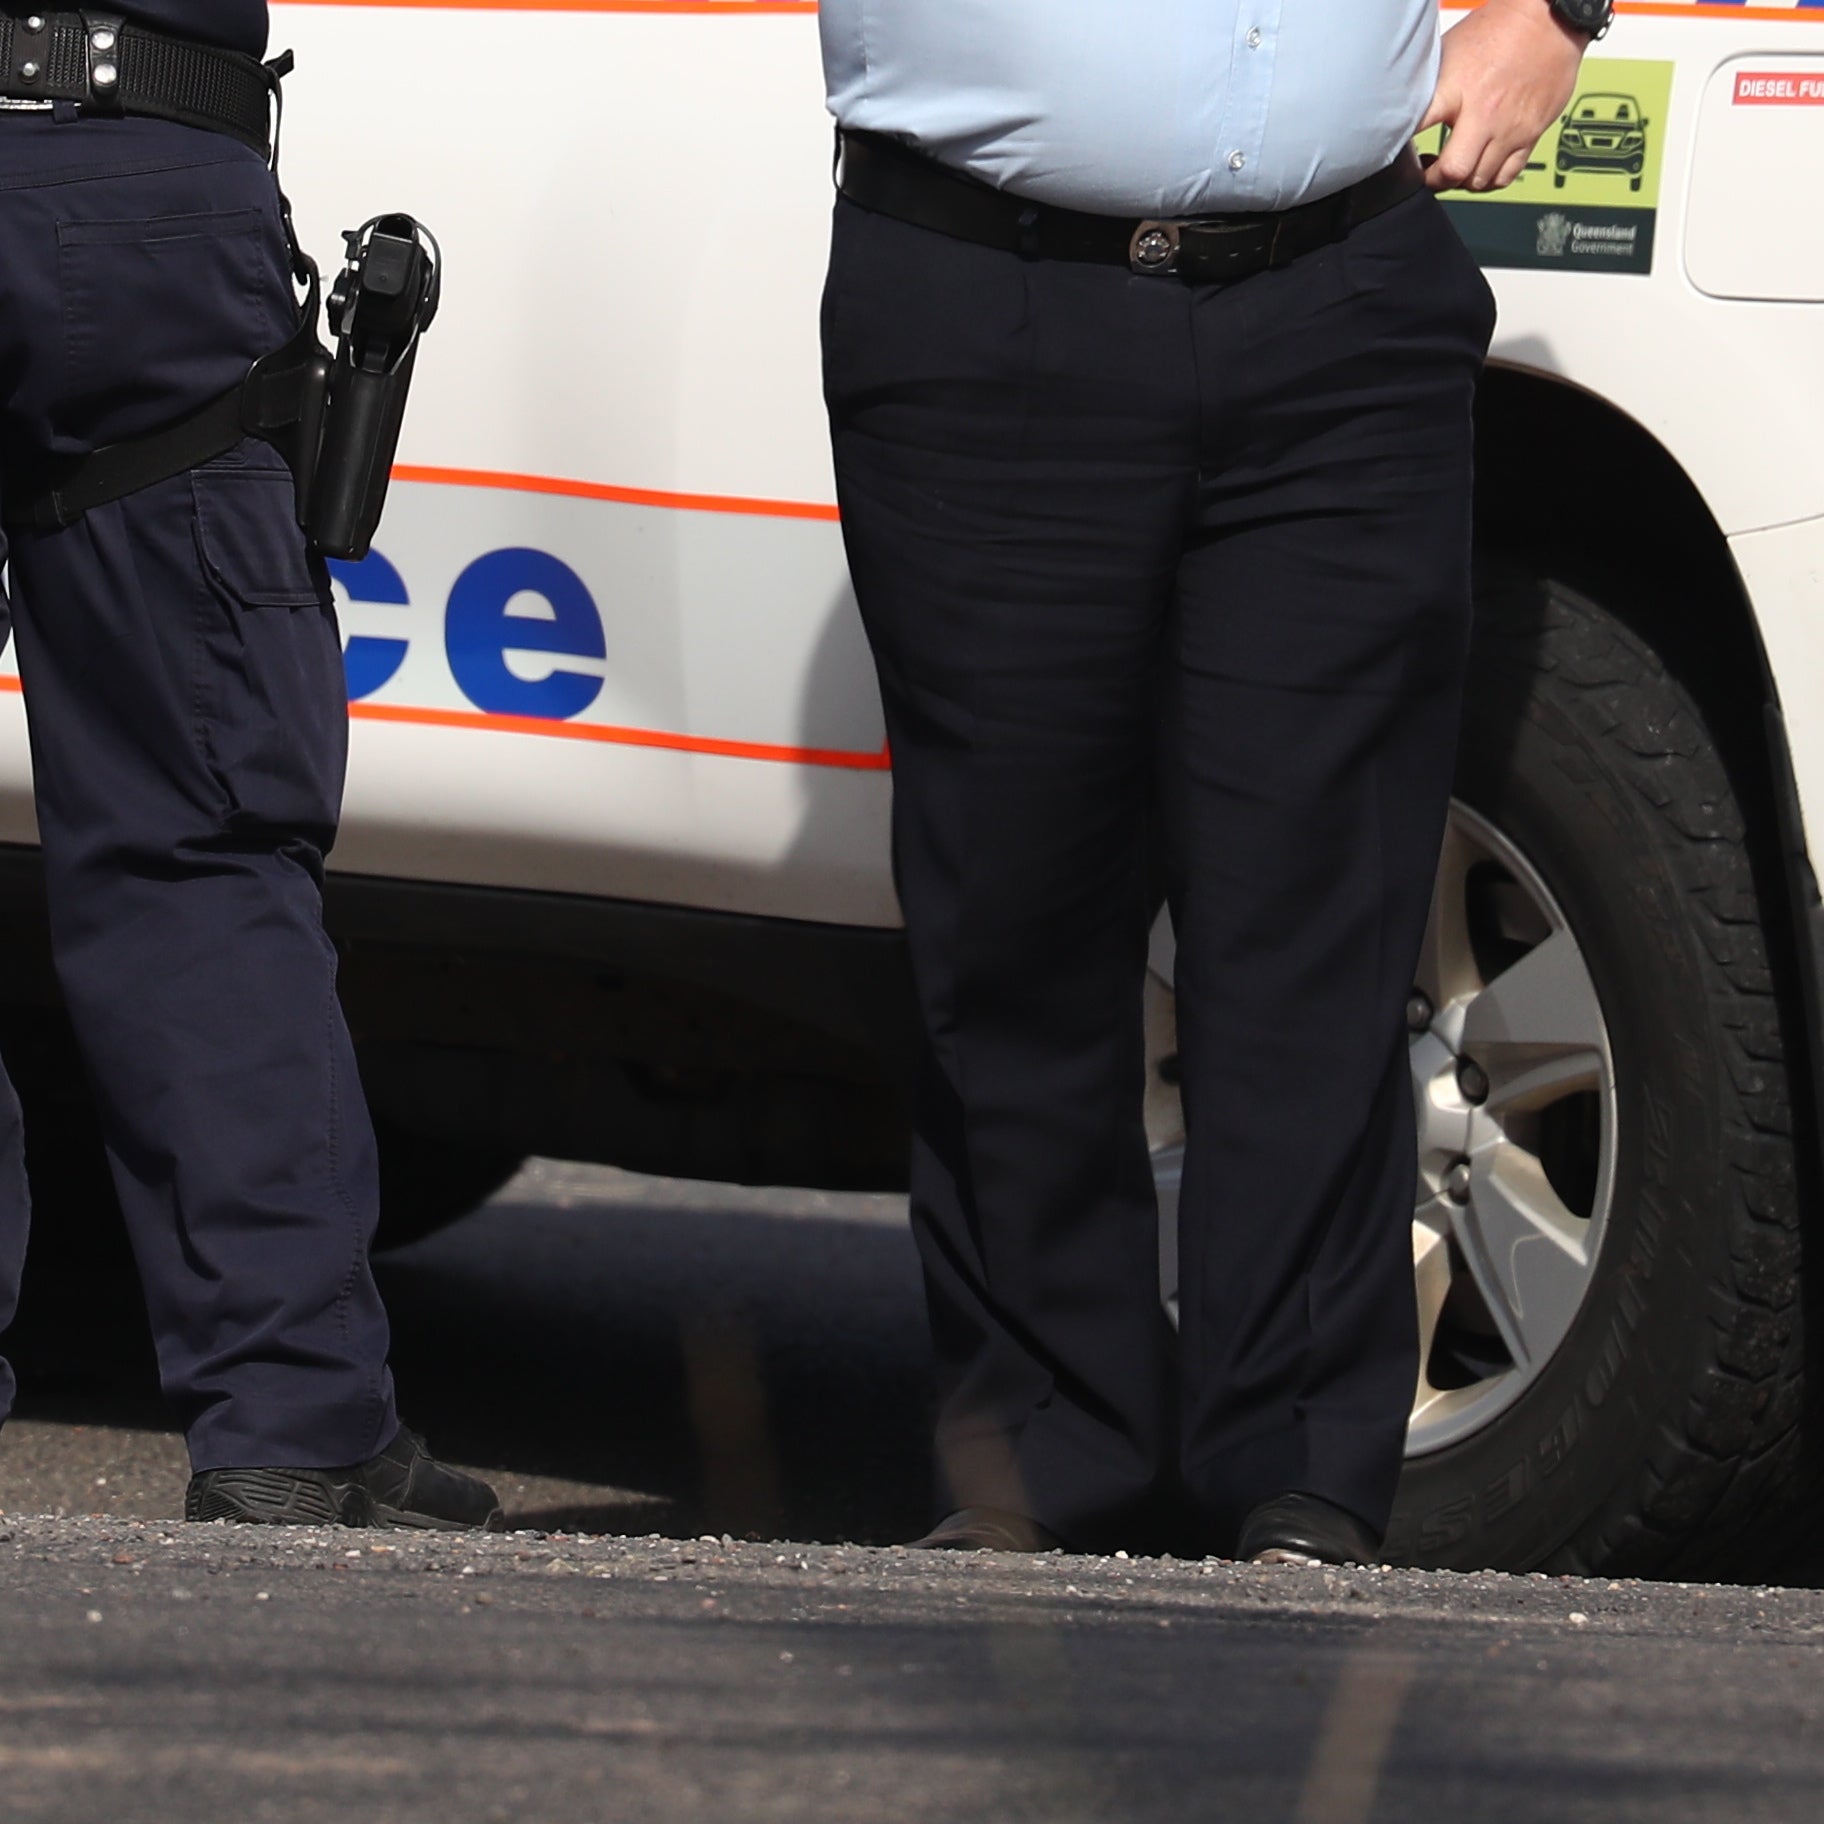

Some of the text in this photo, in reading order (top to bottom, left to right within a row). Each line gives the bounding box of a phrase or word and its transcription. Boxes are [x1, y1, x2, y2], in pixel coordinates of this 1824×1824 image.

[1739, 79, 1795, 97] DIESEL
[1573, 223, 1636, 240] Queensland
[1571, 241, 1634, 255] Government
